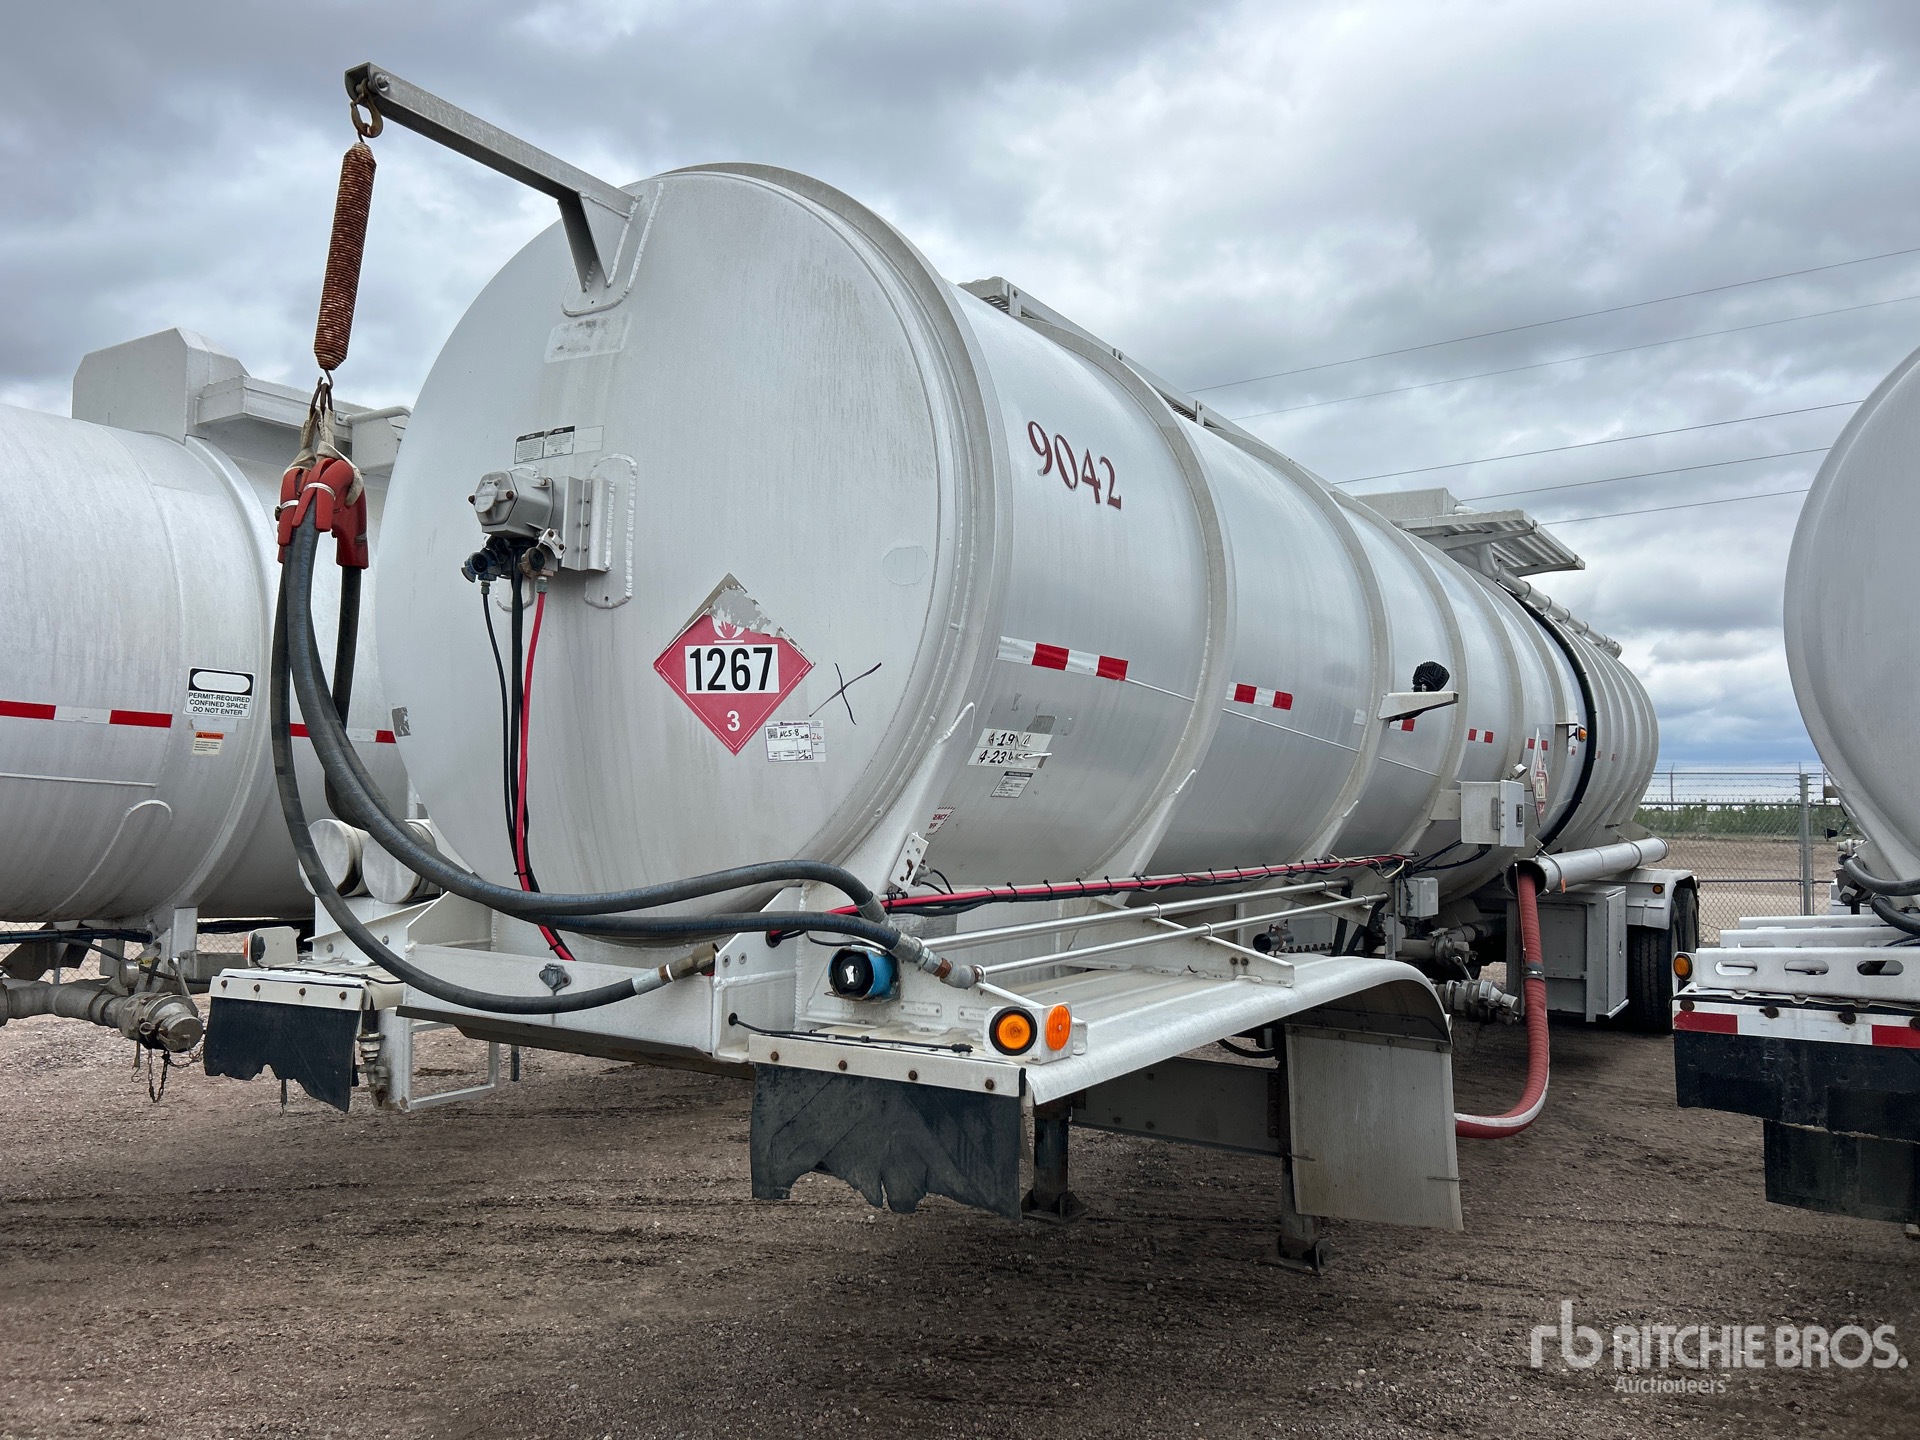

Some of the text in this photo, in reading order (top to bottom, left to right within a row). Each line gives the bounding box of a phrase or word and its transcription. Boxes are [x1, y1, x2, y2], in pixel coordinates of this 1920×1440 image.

[1027, 420, 1122, 510] 9042
[689, 647, 773, 691] 1267
[188, 691, 251, 703] PERMIT-REQUIRED
[189, 699, 248, 710] CONFINED SPACE
[220, 708, 243, 716] ENTER
[726, 710, 741, 732] 3
